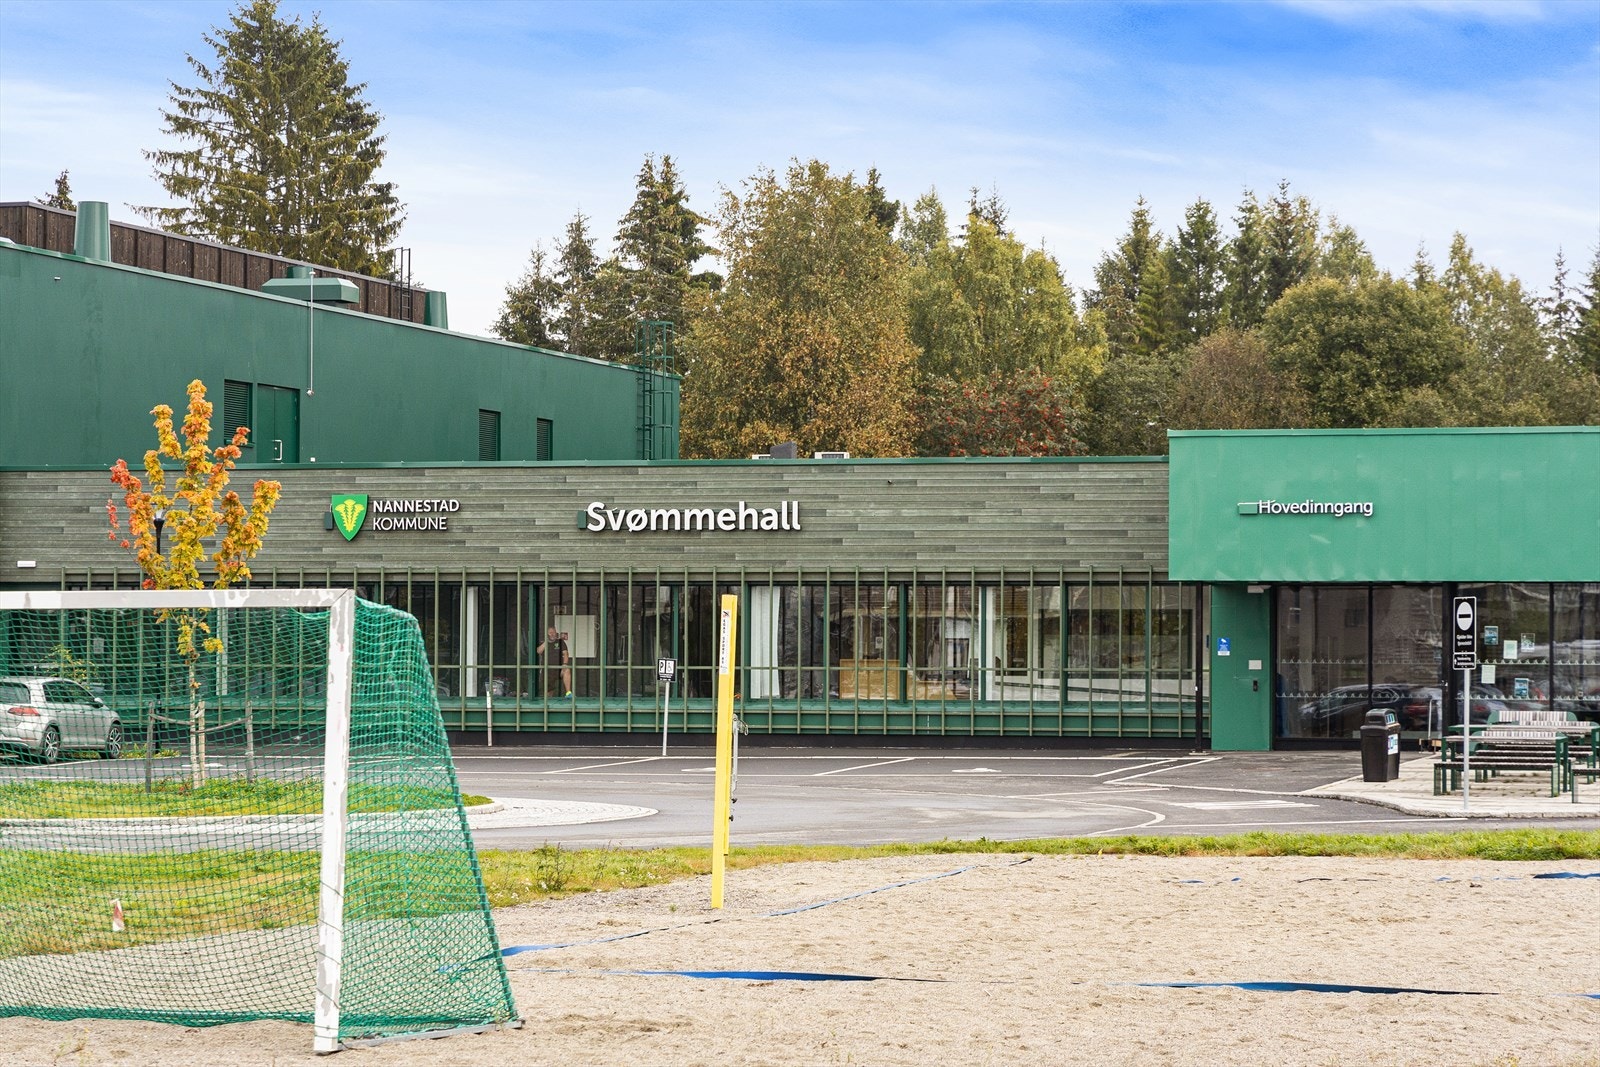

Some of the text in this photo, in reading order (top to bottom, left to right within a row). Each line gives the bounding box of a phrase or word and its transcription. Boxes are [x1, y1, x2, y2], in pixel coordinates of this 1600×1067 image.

[373, 499, 460, 513] NANNESTAD
[1259, 499, 1374, 517] Hovedinngang
[373, 516, 448, 531] KOMMUNE
[586, 500, 802, 533] Svømmehall
